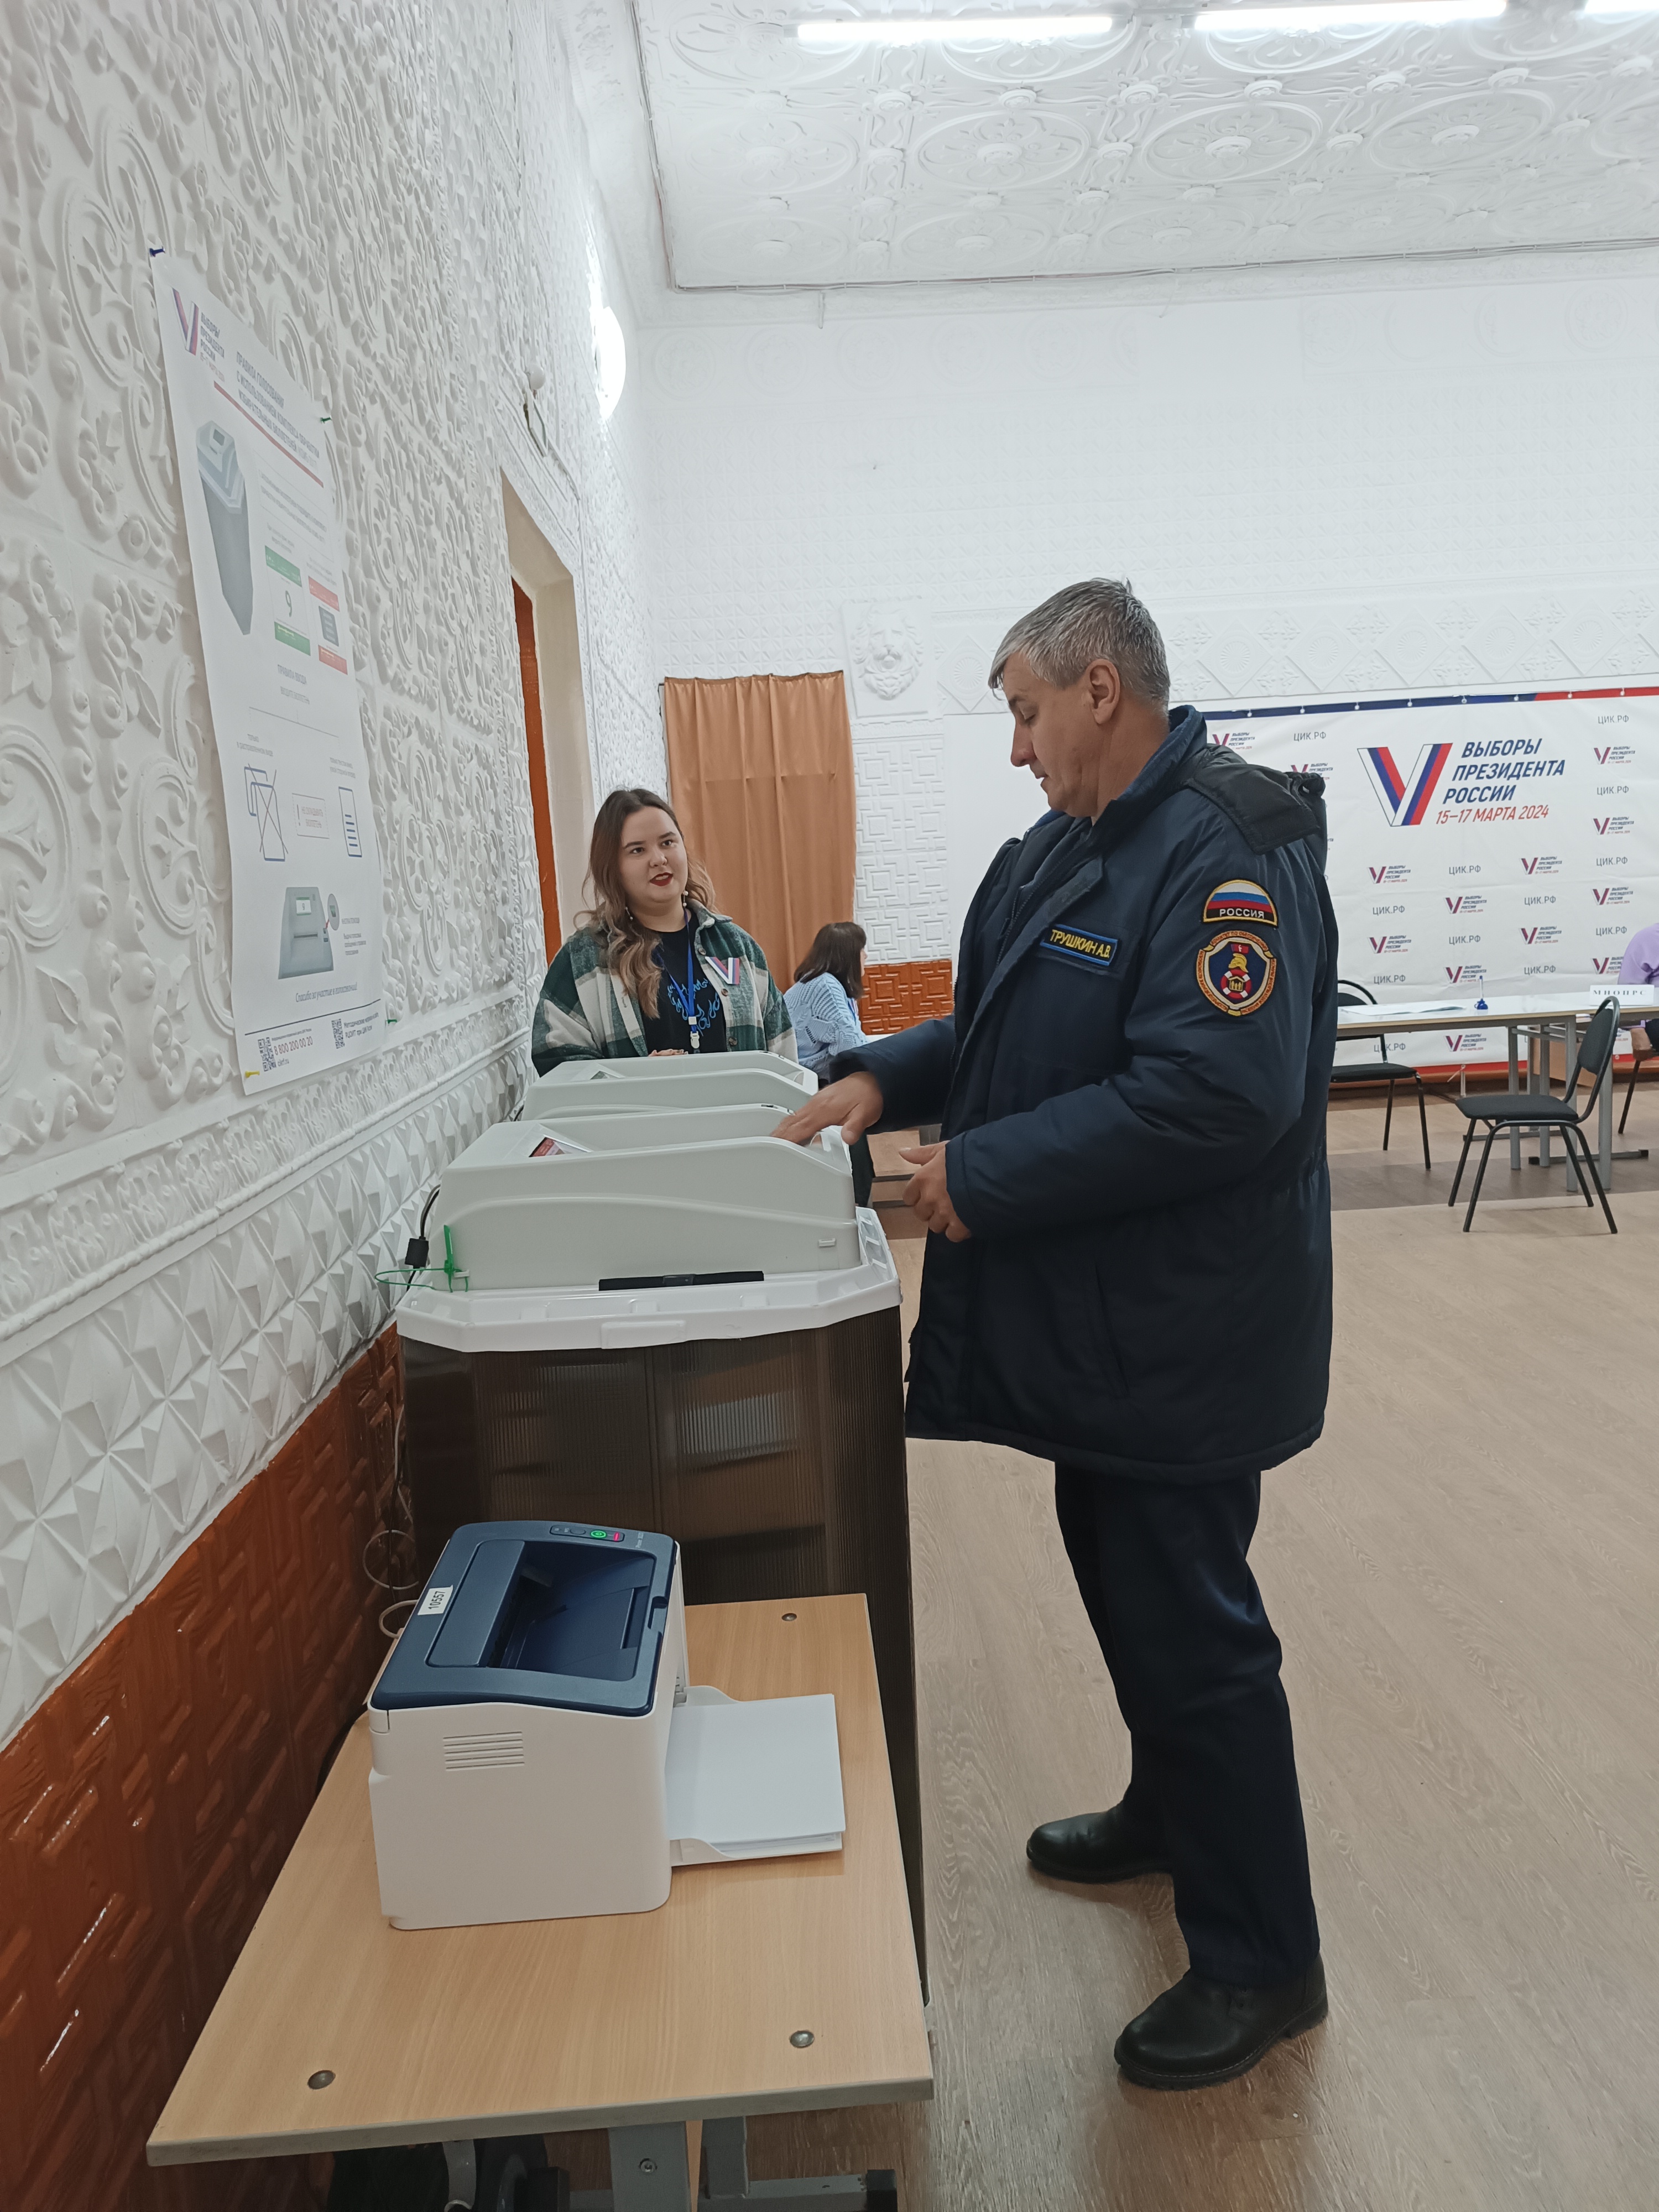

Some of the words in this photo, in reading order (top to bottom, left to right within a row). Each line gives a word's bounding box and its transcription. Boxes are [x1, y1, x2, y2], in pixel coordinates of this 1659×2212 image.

[285, 590, 293, 618] 9
[1598, 715, 1629, 724] ЦИК.РФ
[1293, 732, 1326, 742] ЦИК.РФ
[1461, 738, 1542, 758] ВЫБОРЫ
[1452, 759, 1566, 781] ПРЕЗИДЕНТА
[1442, 785, 1517, 804] РОССИИ
[1597, 785, 1629, 796] ЦИК.РФ
[1472, 806, 1516, 822] МАРТА
[1518, 805, 1549, 820] 2024
[1596, 857, 1627, 867] ЦИК.РФ
[1449, 864, 1481, 875] ЦИК.РФ
[1524, 895, 1556, 906] ЦИК.РФ
[1219, 908, 1265, 919] РОССИЯ
[1373, 905, 1405, 916] ЦИК.РФ
[1595, 926, 1627, 937] ЦИК.РФ
[1050, 929, 1098, 954] ТРУШКИН
[1449, 935, 1481, 946] ЦИК.РФ
[1524, 965, 1556, 975] ЦИК.РФ
[1373, 974, 1406, 985] ЦИК.РФ
[274, 1046, 278, 1056] 8
[278, 1043, 289, 1053] 800
[289, 1040, 299, 1052] 200
[299, 1038, 306, 1048] 00
[306, 1036, 313, 1046] 20
[1374, 1043, 1406, 1053] ЦК.РФ
[428, 1591, 446, 1609] 10557
